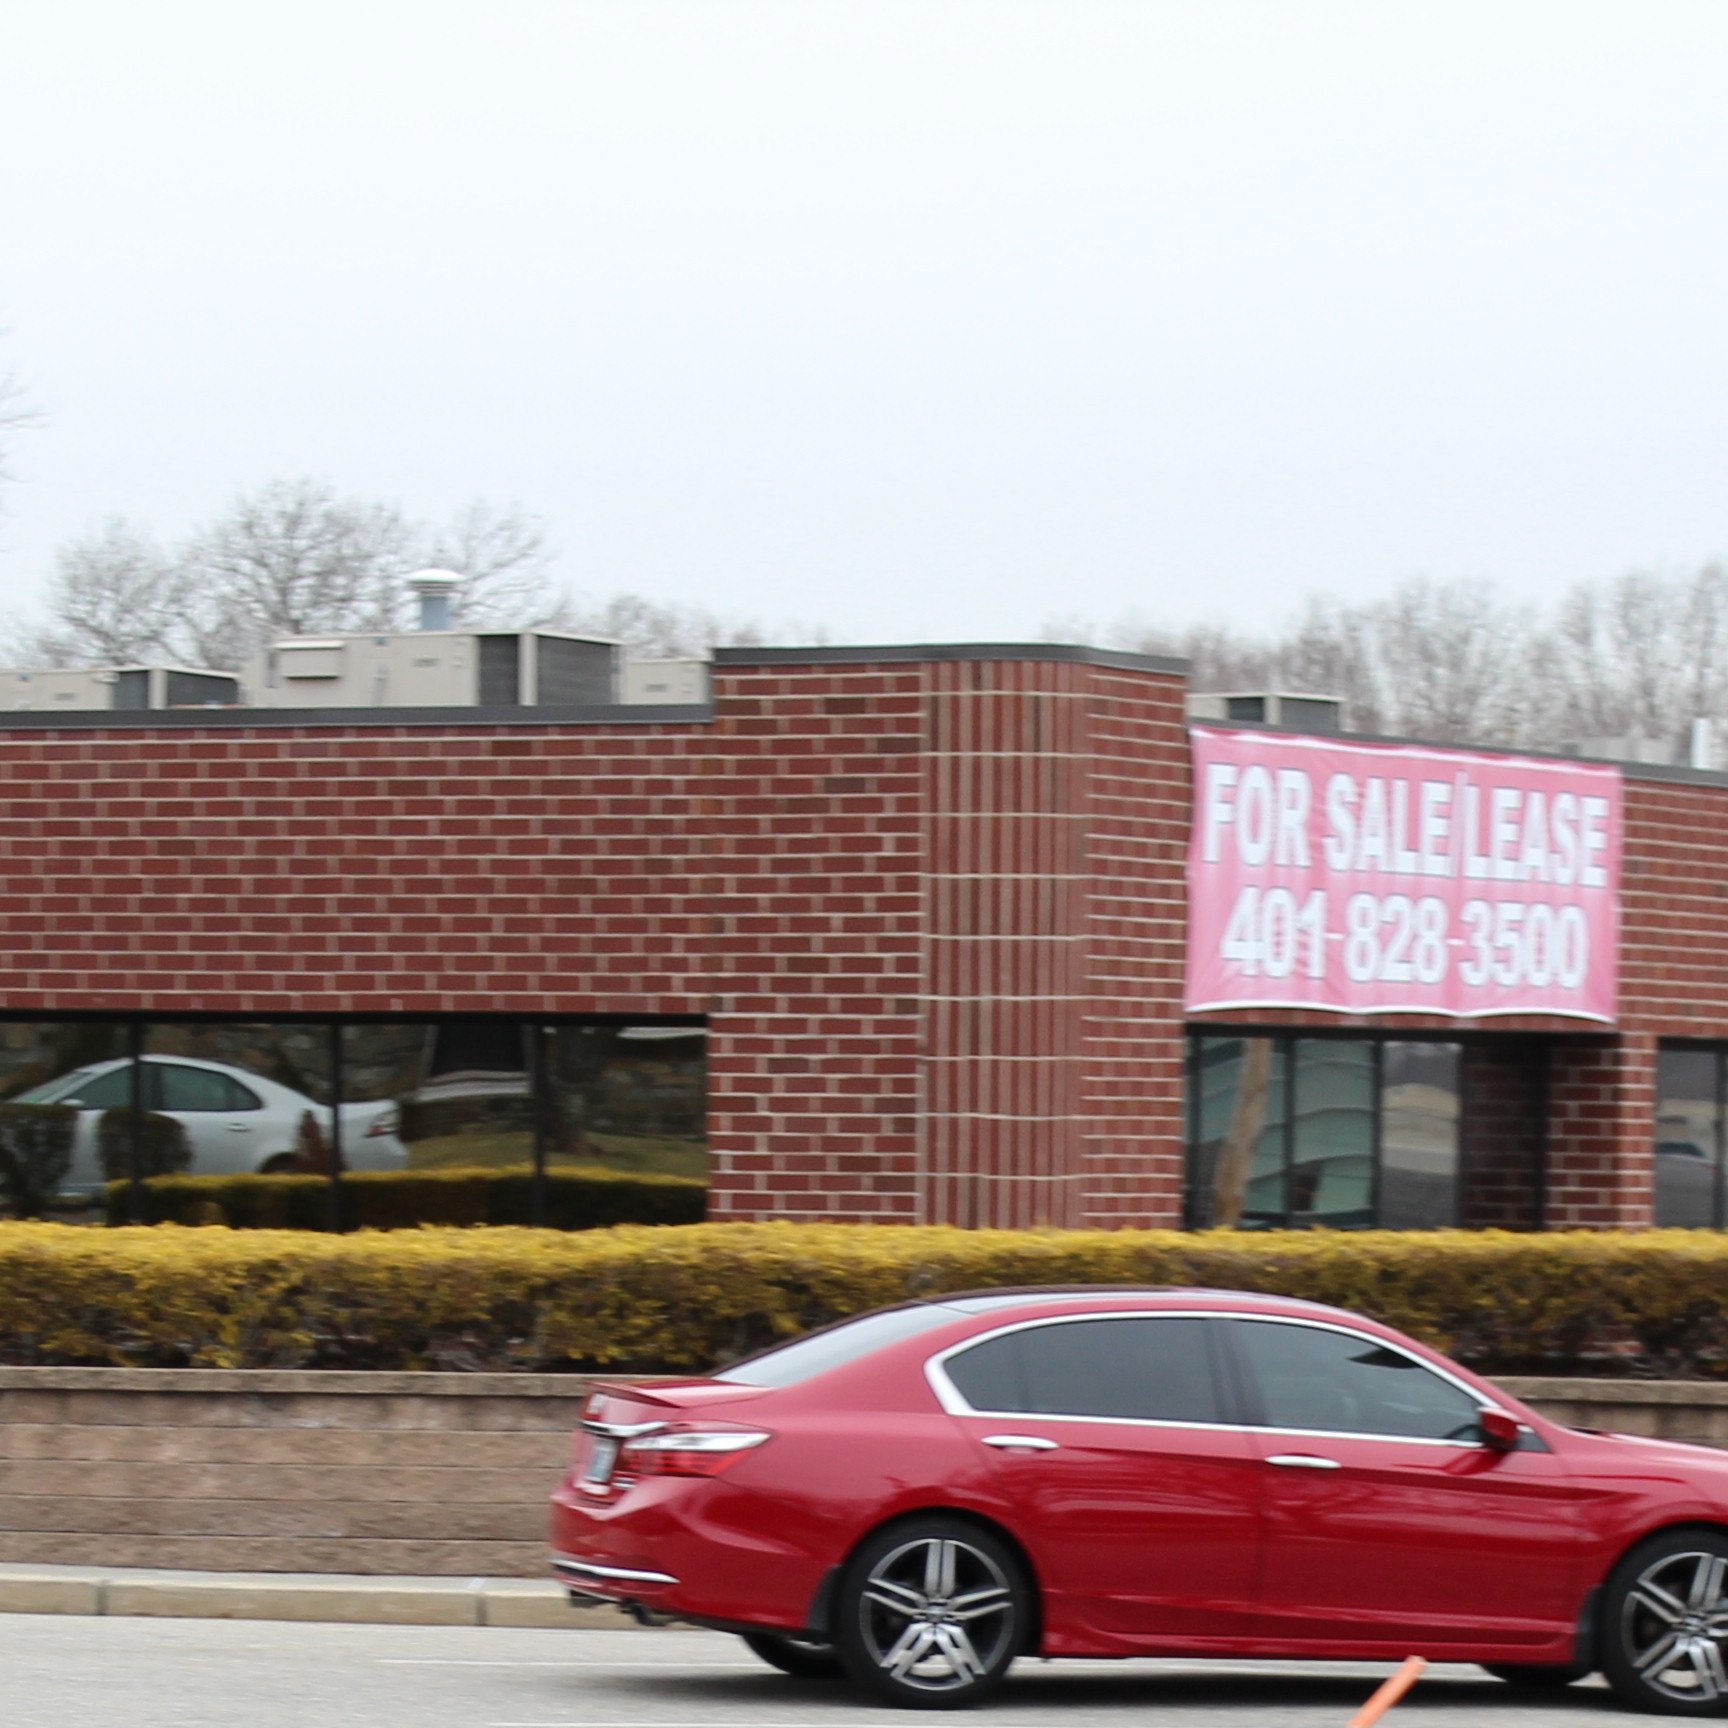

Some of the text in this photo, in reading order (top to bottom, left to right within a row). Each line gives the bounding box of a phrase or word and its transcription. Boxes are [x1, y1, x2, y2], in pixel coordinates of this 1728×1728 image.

[1202, 763, 1610, 889] FOR SALE/LEASE
[1220, 884, 1589, 990] 401-828-3500
